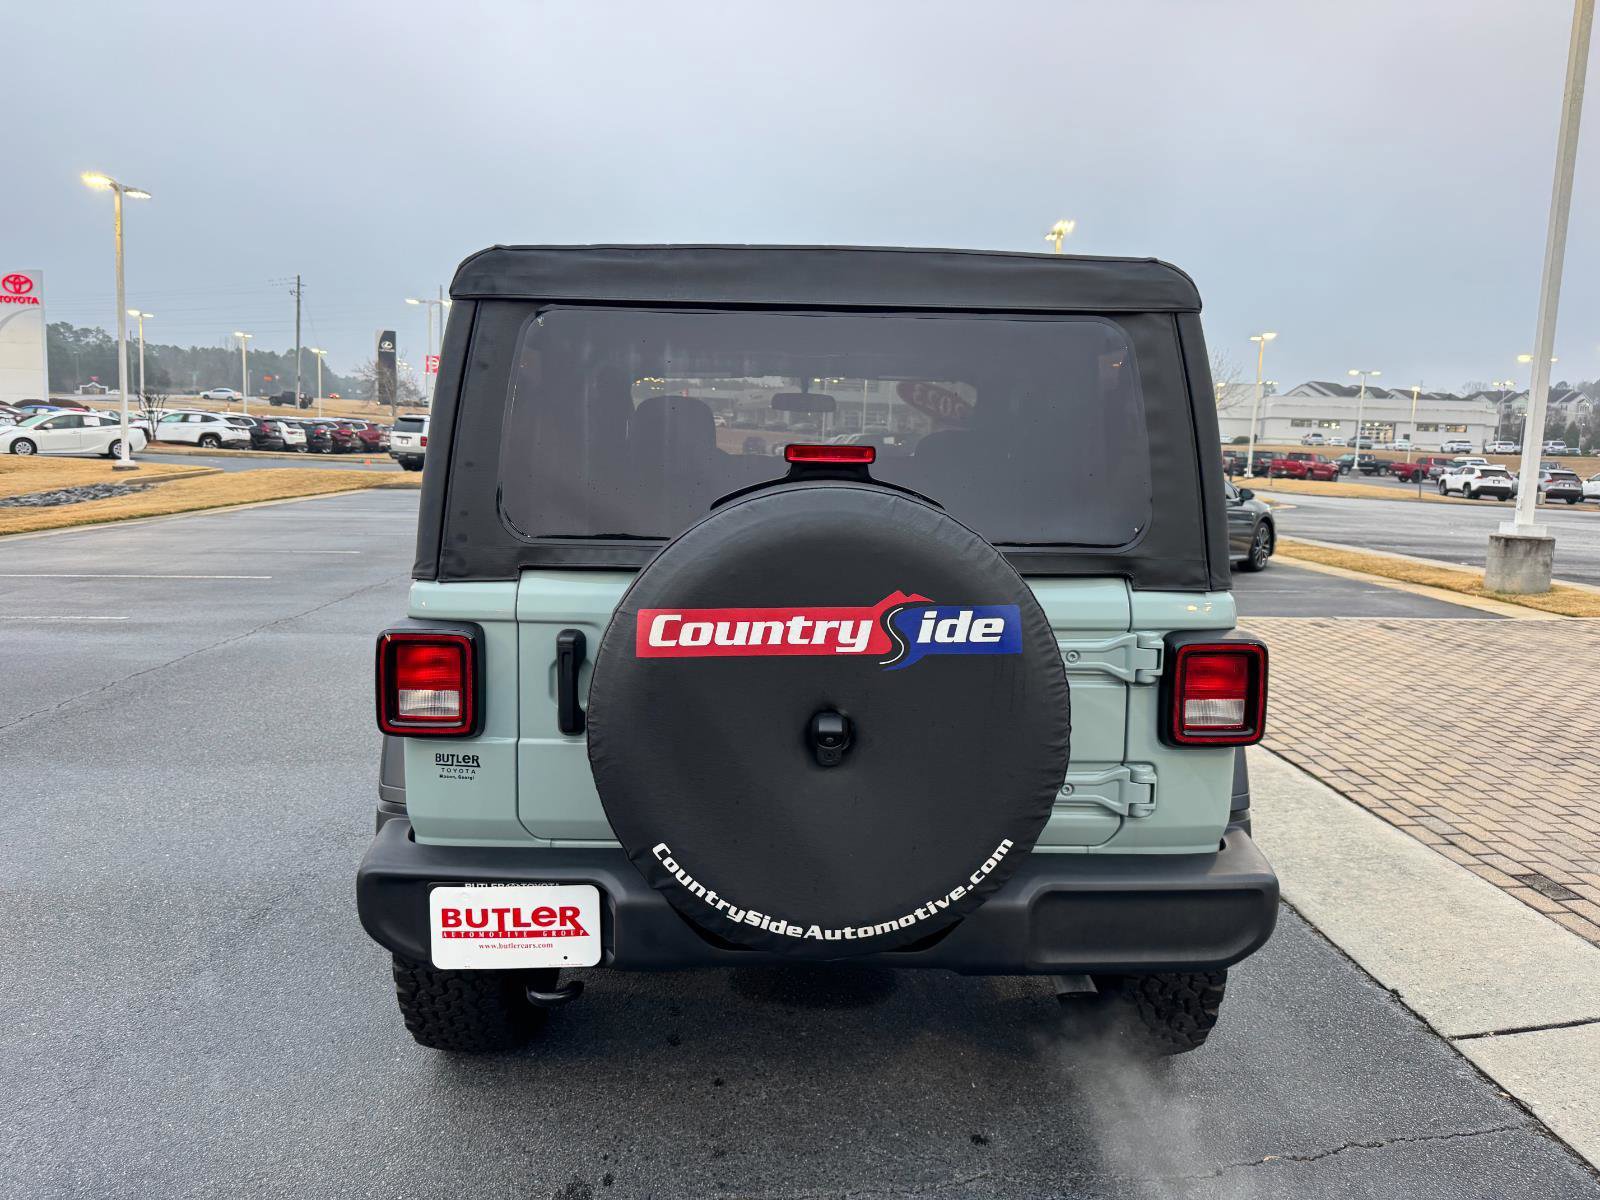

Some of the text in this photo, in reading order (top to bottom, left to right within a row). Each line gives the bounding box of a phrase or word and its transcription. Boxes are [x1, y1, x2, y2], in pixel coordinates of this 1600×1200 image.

[0, 295, 40, 305] TOYOTA
[441, 767, 476, 775] TOYOTA
[652, 838, 1014, 940] CountrySideAutomotive.com
[542, 929, 585, 937] GROUP
[478, 942, 553, 950] www.butlercars.com
